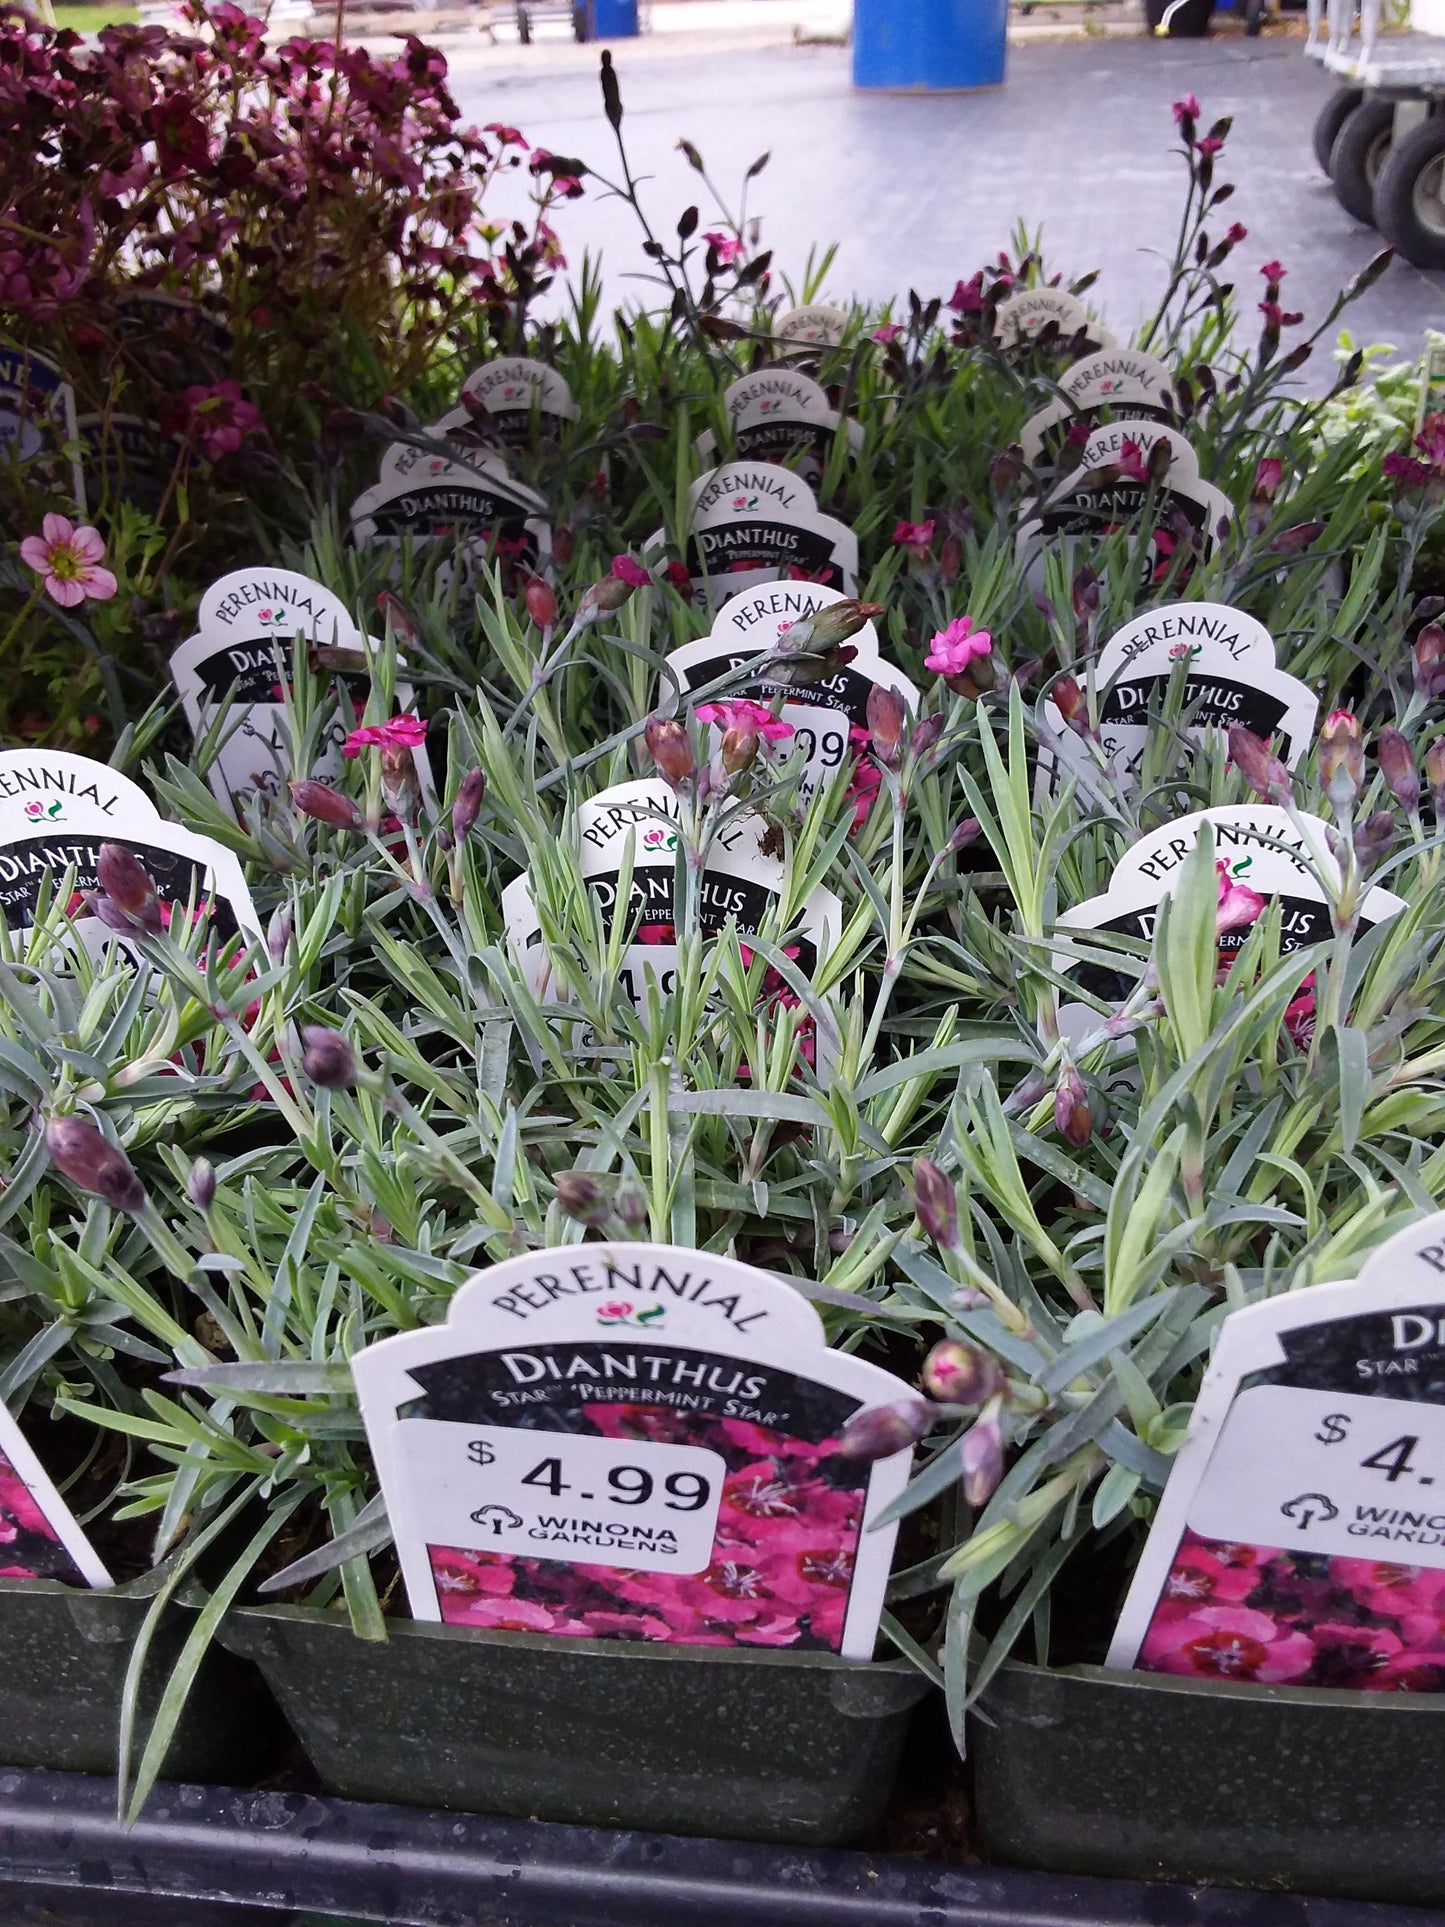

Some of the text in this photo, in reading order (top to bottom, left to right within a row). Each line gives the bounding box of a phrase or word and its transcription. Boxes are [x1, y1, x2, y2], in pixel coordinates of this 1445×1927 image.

[1068, 359, 1156, 397] PERENNIAL
[729, 379, 813, 417] PERENNIAL
[1082, 431, 1179, 469] PERENN
[400, 494, 494, 518] DIANTHUS
[697, 473, 796, 513] PERENNIAL
[700, 529, 800, 554] DIANTHUS
[216, 581, 327, 626] PERENNIAL
[1121, 616, 1251, 661] PERENNIAL
[1117, 683, 1244, 711] DITHUS
[582, 795, 744, 852] PERENL
[1138, 822, 1314, 881] PERNNIAL
[588, 878, 747, 912] DANHUS
[491, 1261, 771, 1335] PERENNIAL
[500, 1352, 767, 1400] DIANTHUS
[1314, 1414, 1351, 1444] $
[467, 1440, 711, 1512] $ 4.99
[527, 1526, 679, 1554] GARDENS
[537, 1516, 678, 1542] WINONA
